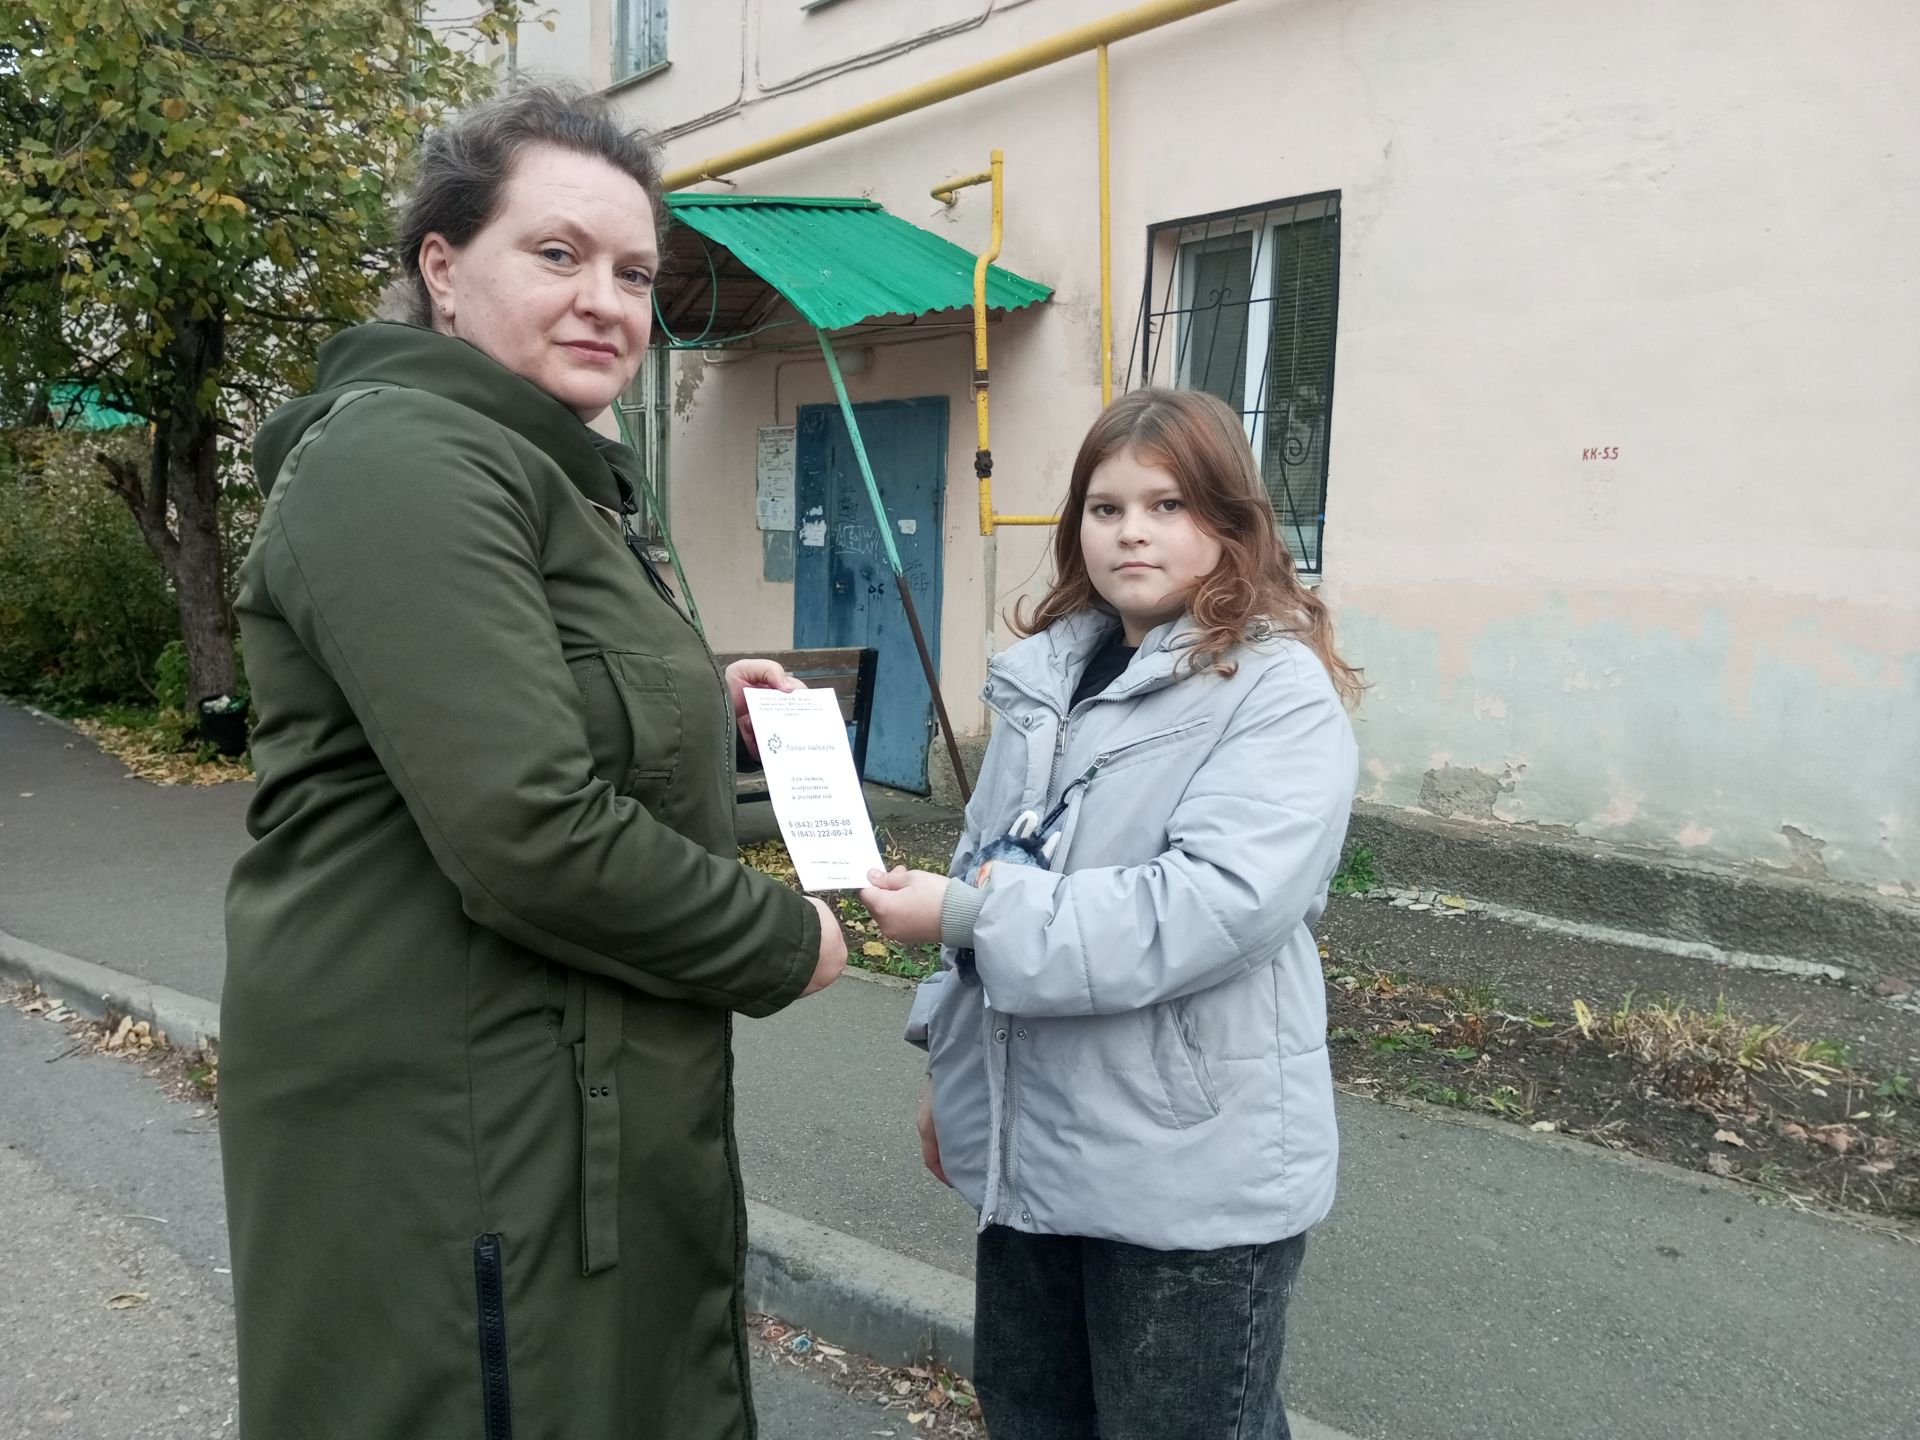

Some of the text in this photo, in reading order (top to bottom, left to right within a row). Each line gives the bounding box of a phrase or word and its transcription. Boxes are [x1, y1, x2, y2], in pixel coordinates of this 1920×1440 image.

[794, 820, 813, 829] (843)
[797, 830, 816, 838] (843)
[817, 829, 853, 837] 222-00-24
